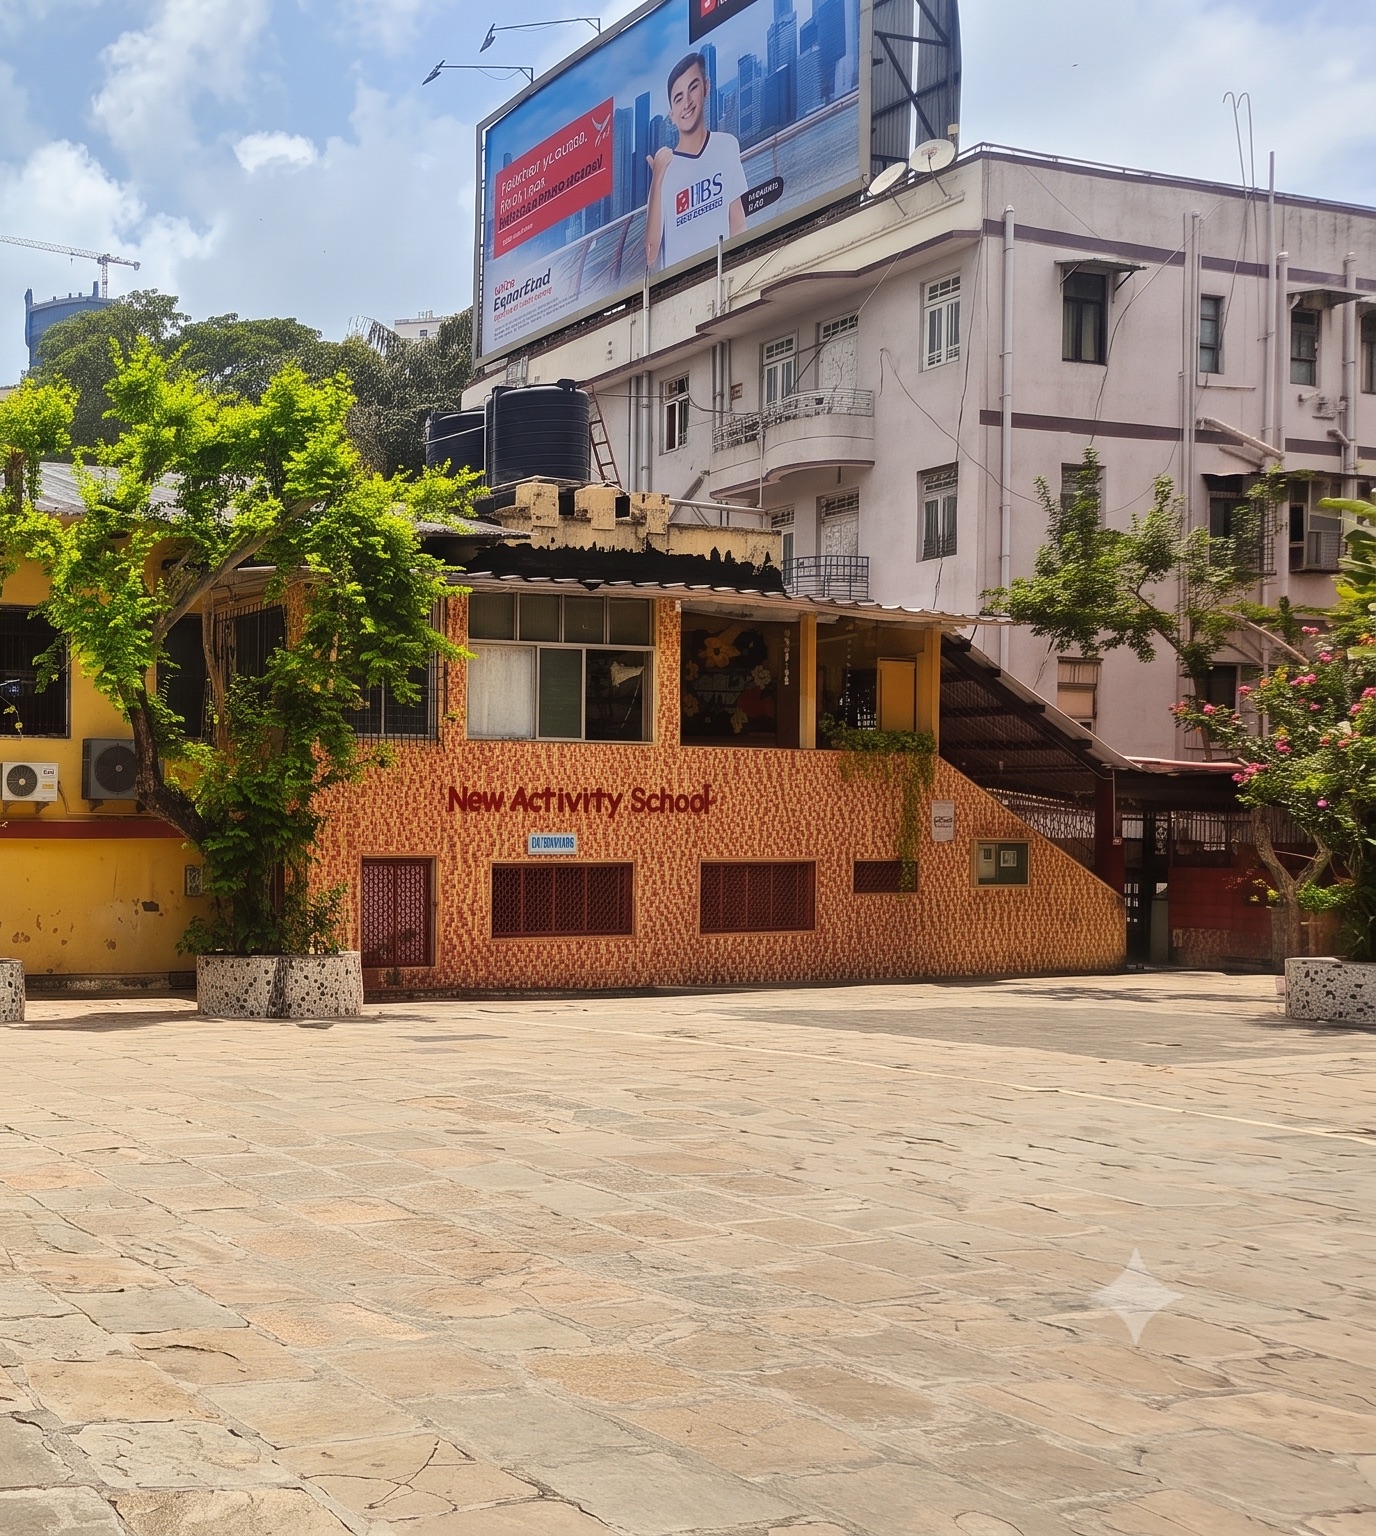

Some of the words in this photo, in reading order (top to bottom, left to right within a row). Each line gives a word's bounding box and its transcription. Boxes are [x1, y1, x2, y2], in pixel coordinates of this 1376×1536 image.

[448, 785, 505, 813] New
[509, 786, 623, 818] Activity
[630, 784, 711, 815] School
